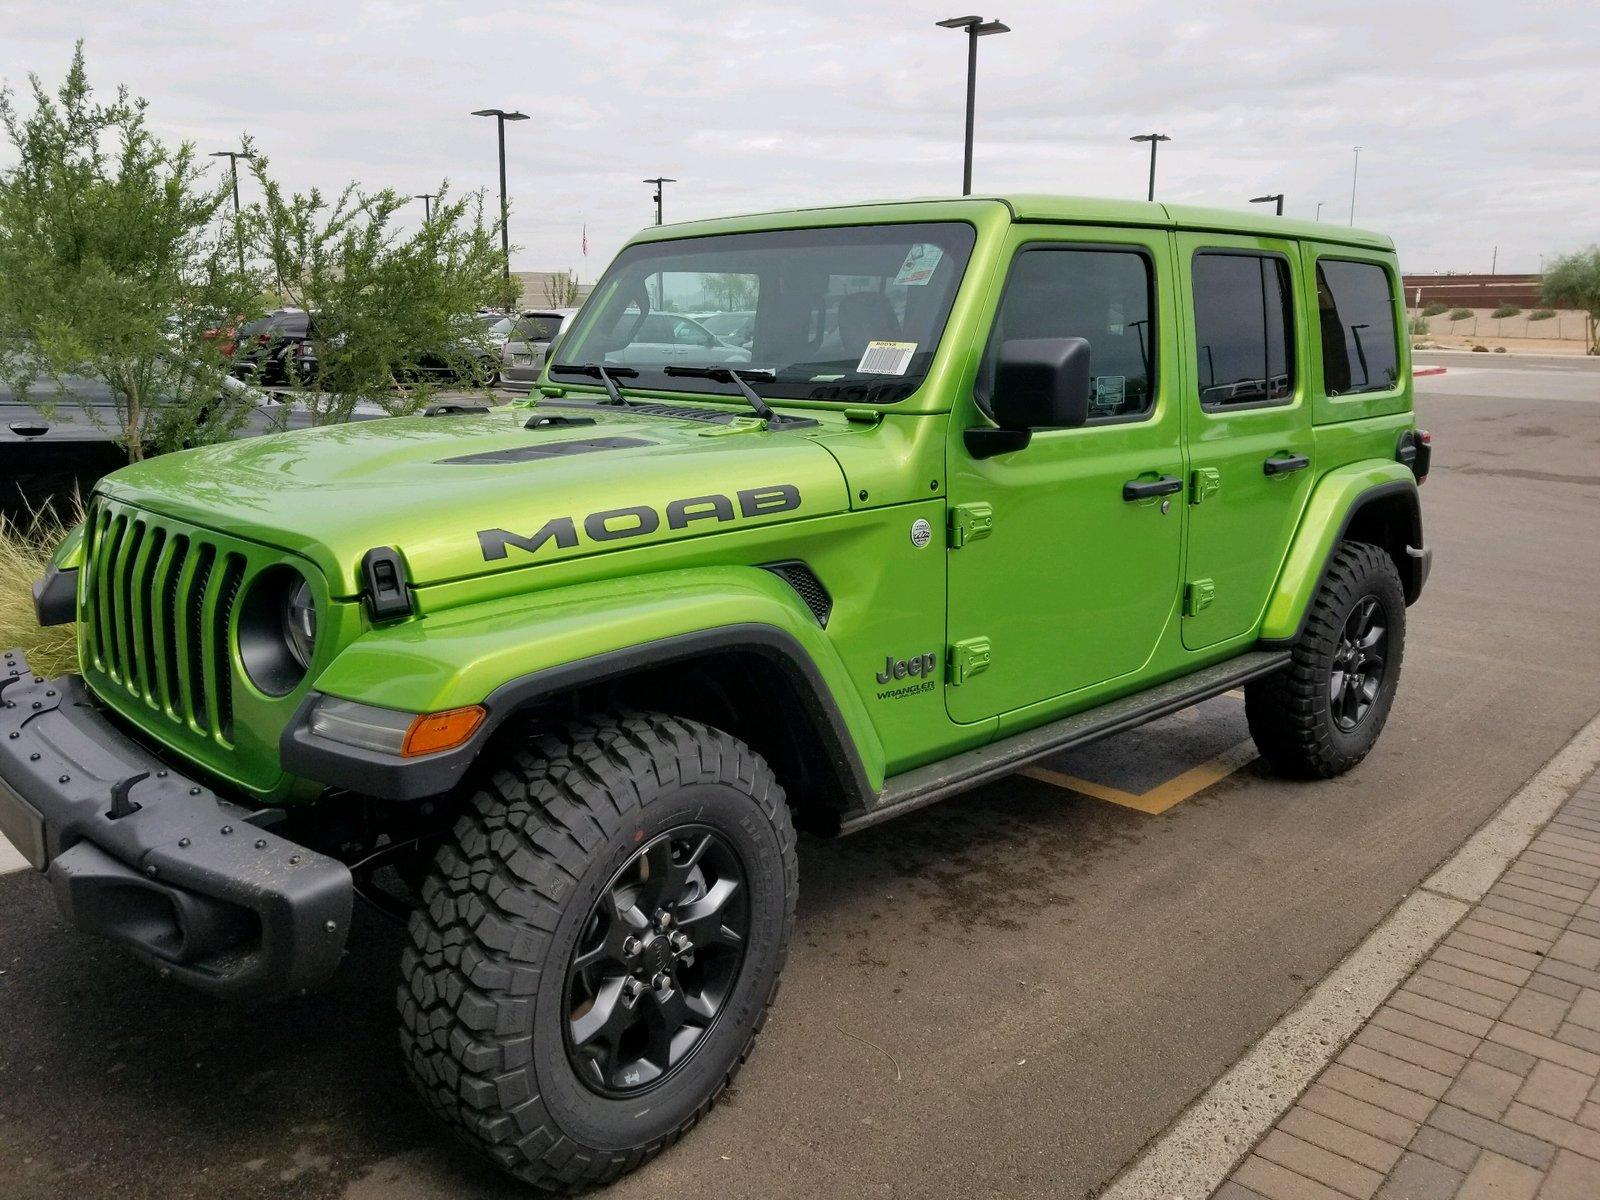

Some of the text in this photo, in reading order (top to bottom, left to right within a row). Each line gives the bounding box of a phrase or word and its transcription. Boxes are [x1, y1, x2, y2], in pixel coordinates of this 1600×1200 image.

[477, 484, 801, 561] MOAB
[876, 651, 936, 684] Jeep
[877, 681, 935, 699] WRANGLER
